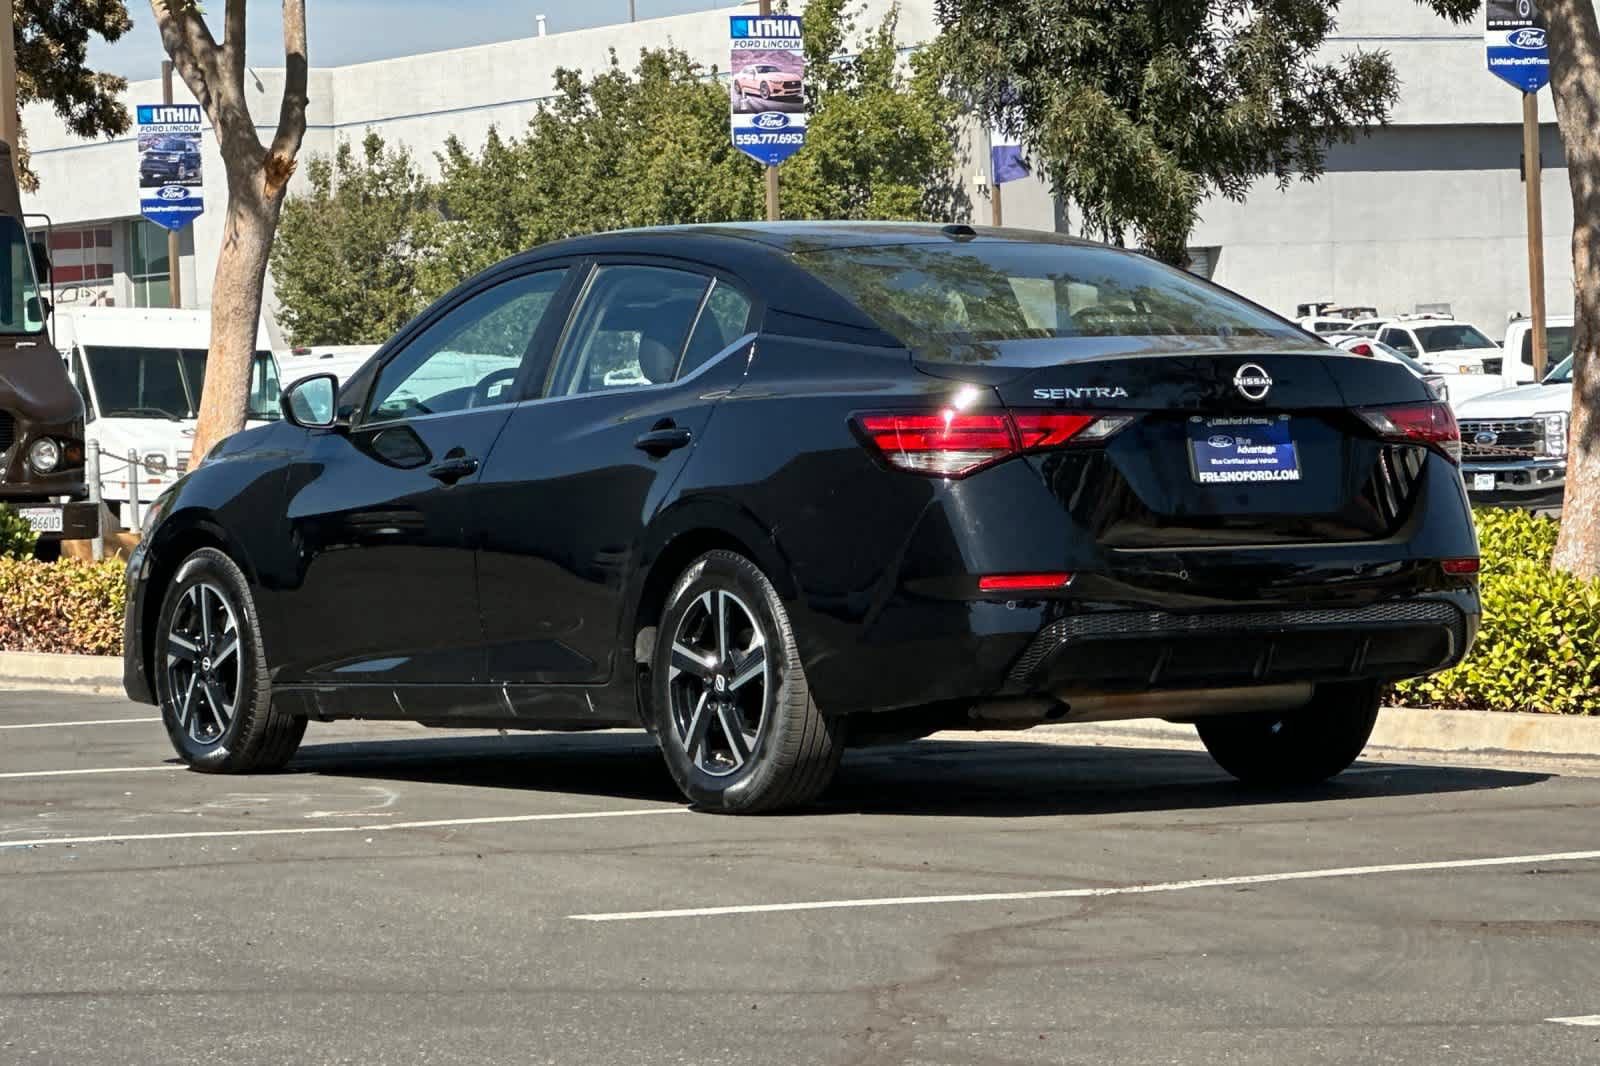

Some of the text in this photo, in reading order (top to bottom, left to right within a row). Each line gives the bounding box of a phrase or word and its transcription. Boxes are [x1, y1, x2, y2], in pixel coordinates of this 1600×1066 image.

[748, 19, 801, 37] LITHIA
[734, 40, 801, 48] FORD LINCOLN
[1516, 30, 1545, 46] Ford
[152, 107, 200, 123] LITHIA
[757, 114, 784, 128] Ford
[140, 125, 164, 133] FORD
[736, 133, 804, 145] 559.777.6952
[162, 187, 185, 199] Ford
[1233, 376, 1273, 386] NISSAN
[1033, 386, 1129, 400] SENTRA
[1237, 446, 1276, 455] Advantage
